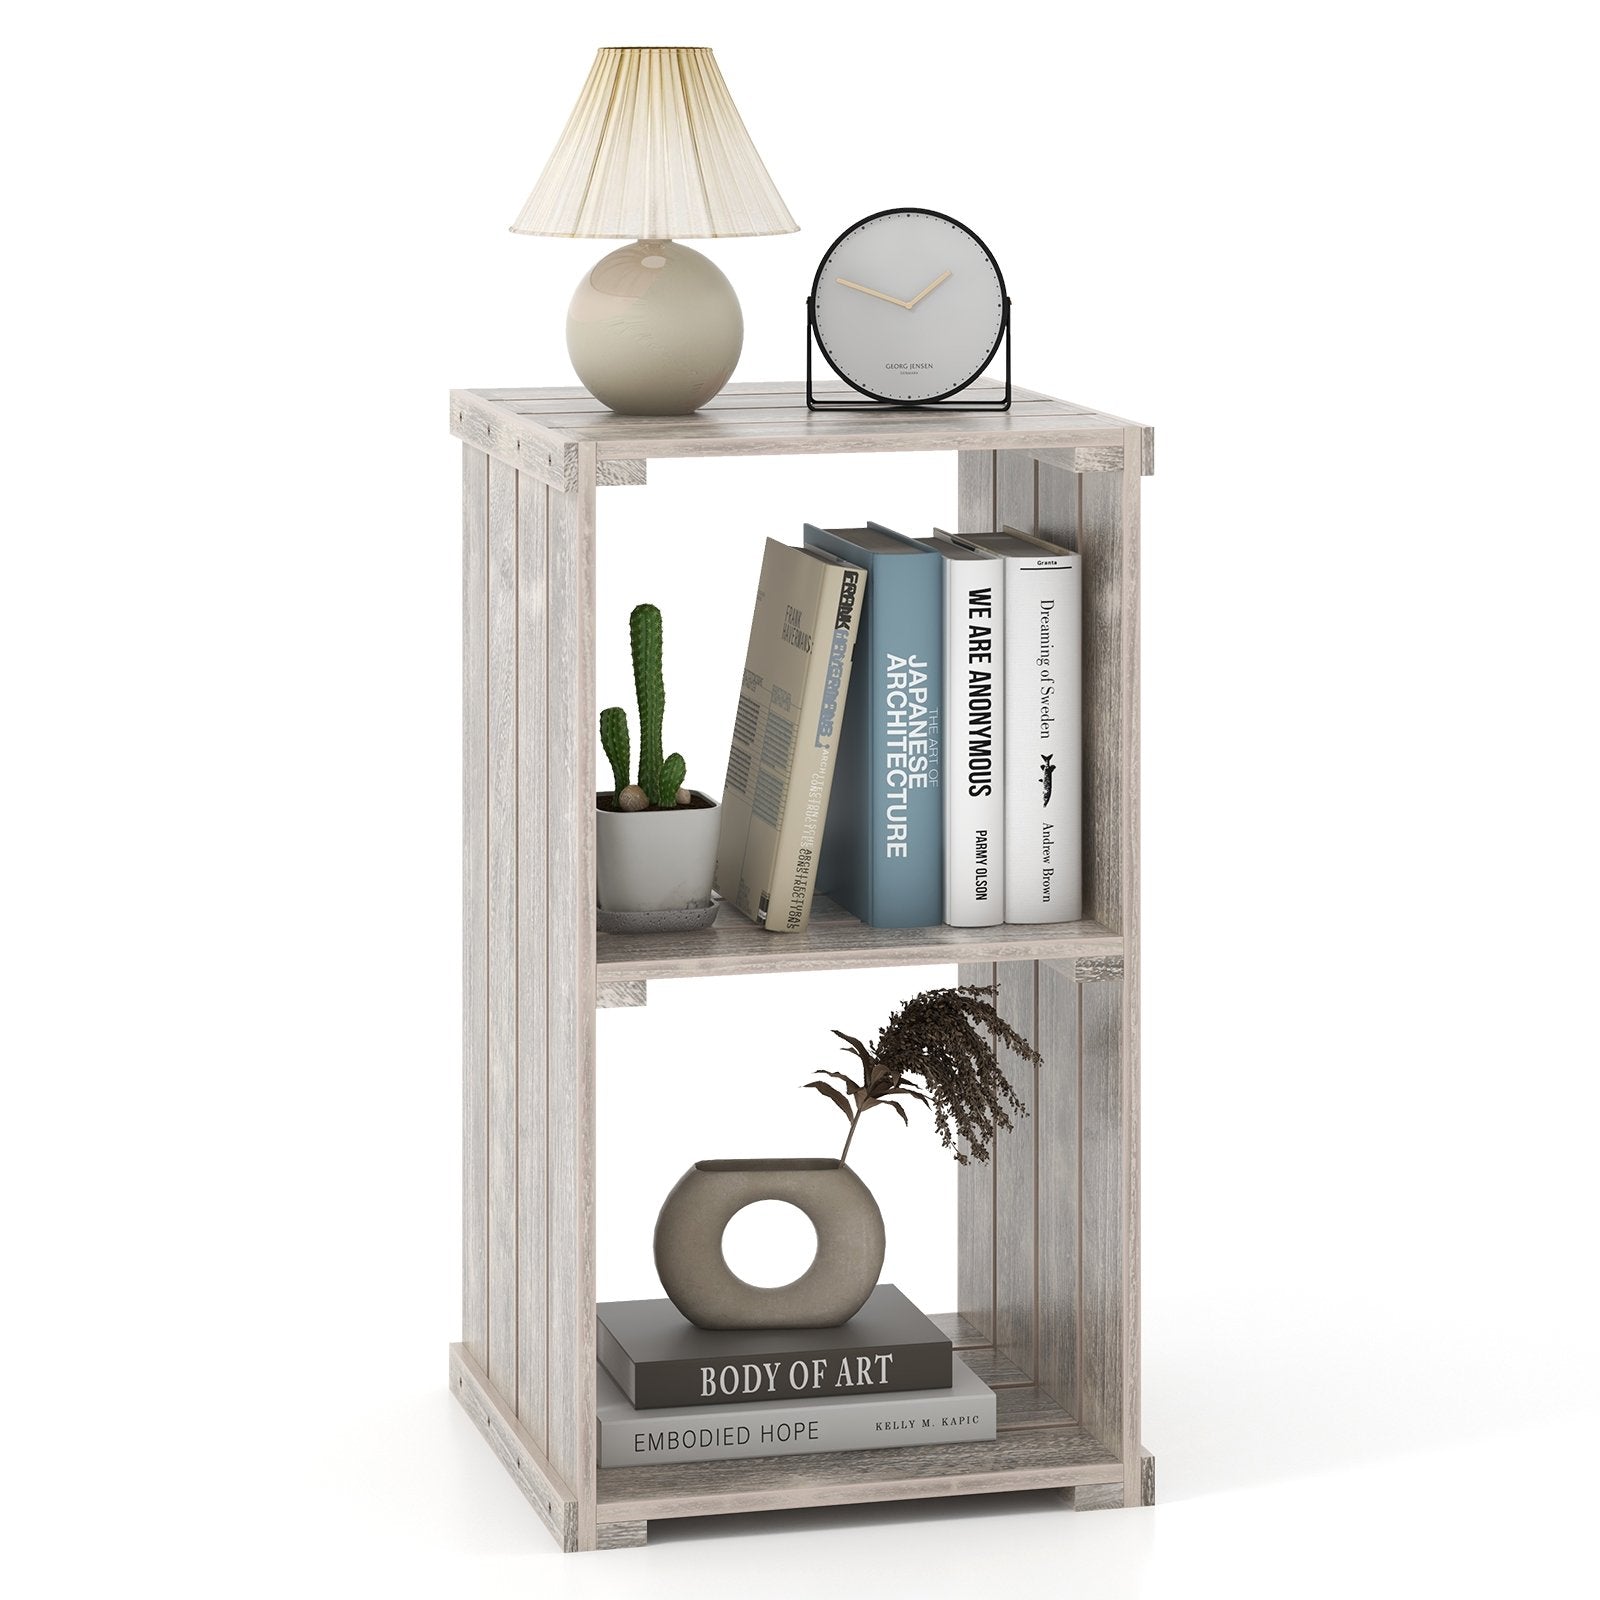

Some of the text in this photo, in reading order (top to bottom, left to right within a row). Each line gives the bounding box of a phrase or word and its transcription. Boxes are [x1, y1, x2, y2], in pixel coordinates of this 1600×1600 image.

[834, 569, 859, 631] FRANK
[969, 587, 992, 797] WE ARE ANONYMOUS
[1036, 600, 1055, 739] Dreaming of Sweden
[886, 653, 908, 858] ARCHITECTURE
[908, 654, 928, 789] JAPANESE
[928, 707, 938, 787] THE ART OF
[786, 848, 806, 930] CONSTRUCTIONS
[793, 848, 813, 928] ARCHITECTURAL
[975, 830, 988, 900] PARMY OLSON
[1042, 822, 1055, 902] Andrew Brown
[700, 1352, 894, 1397] BODY OF ART
[634, 1420, 819, 1453] EMBODIED HOPE
[875, 1415, 980, 1432] KELLY M. KAPIC
